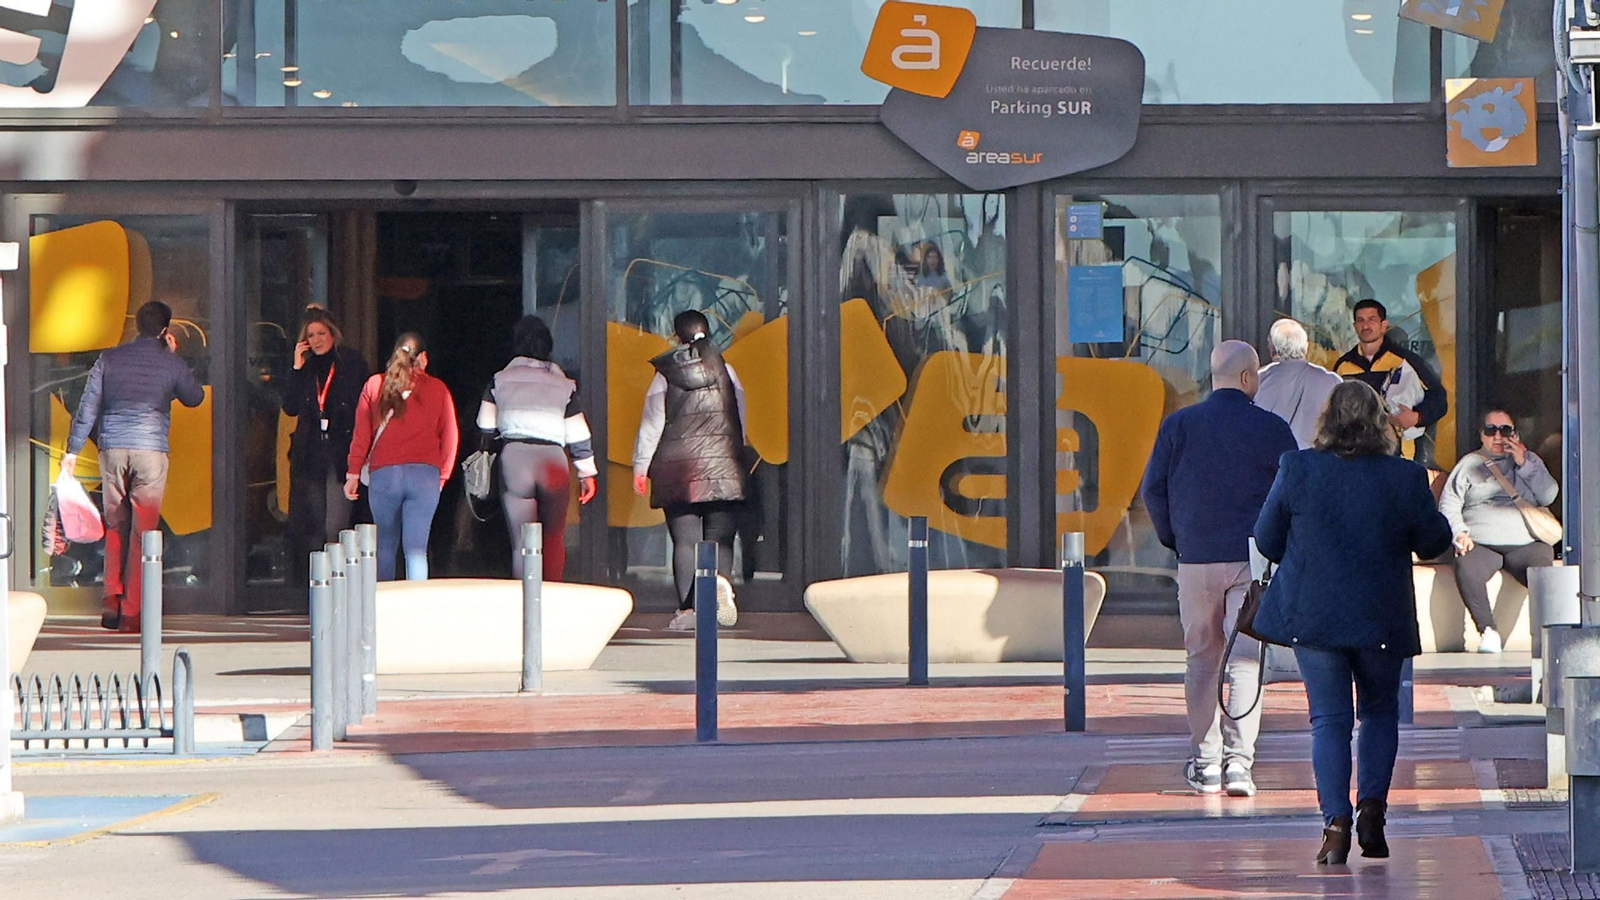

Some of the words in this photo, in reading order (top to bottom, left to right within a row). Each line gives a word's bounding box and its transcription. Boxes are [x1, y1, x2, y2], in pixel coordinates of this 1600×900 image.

[1011, 56, 1092, 71] Recuerde!
[991, 99, 1052, 119] Parking
[1057, 100, 1092, 115] SUR
[965, 152, 1044, 165] areasur
